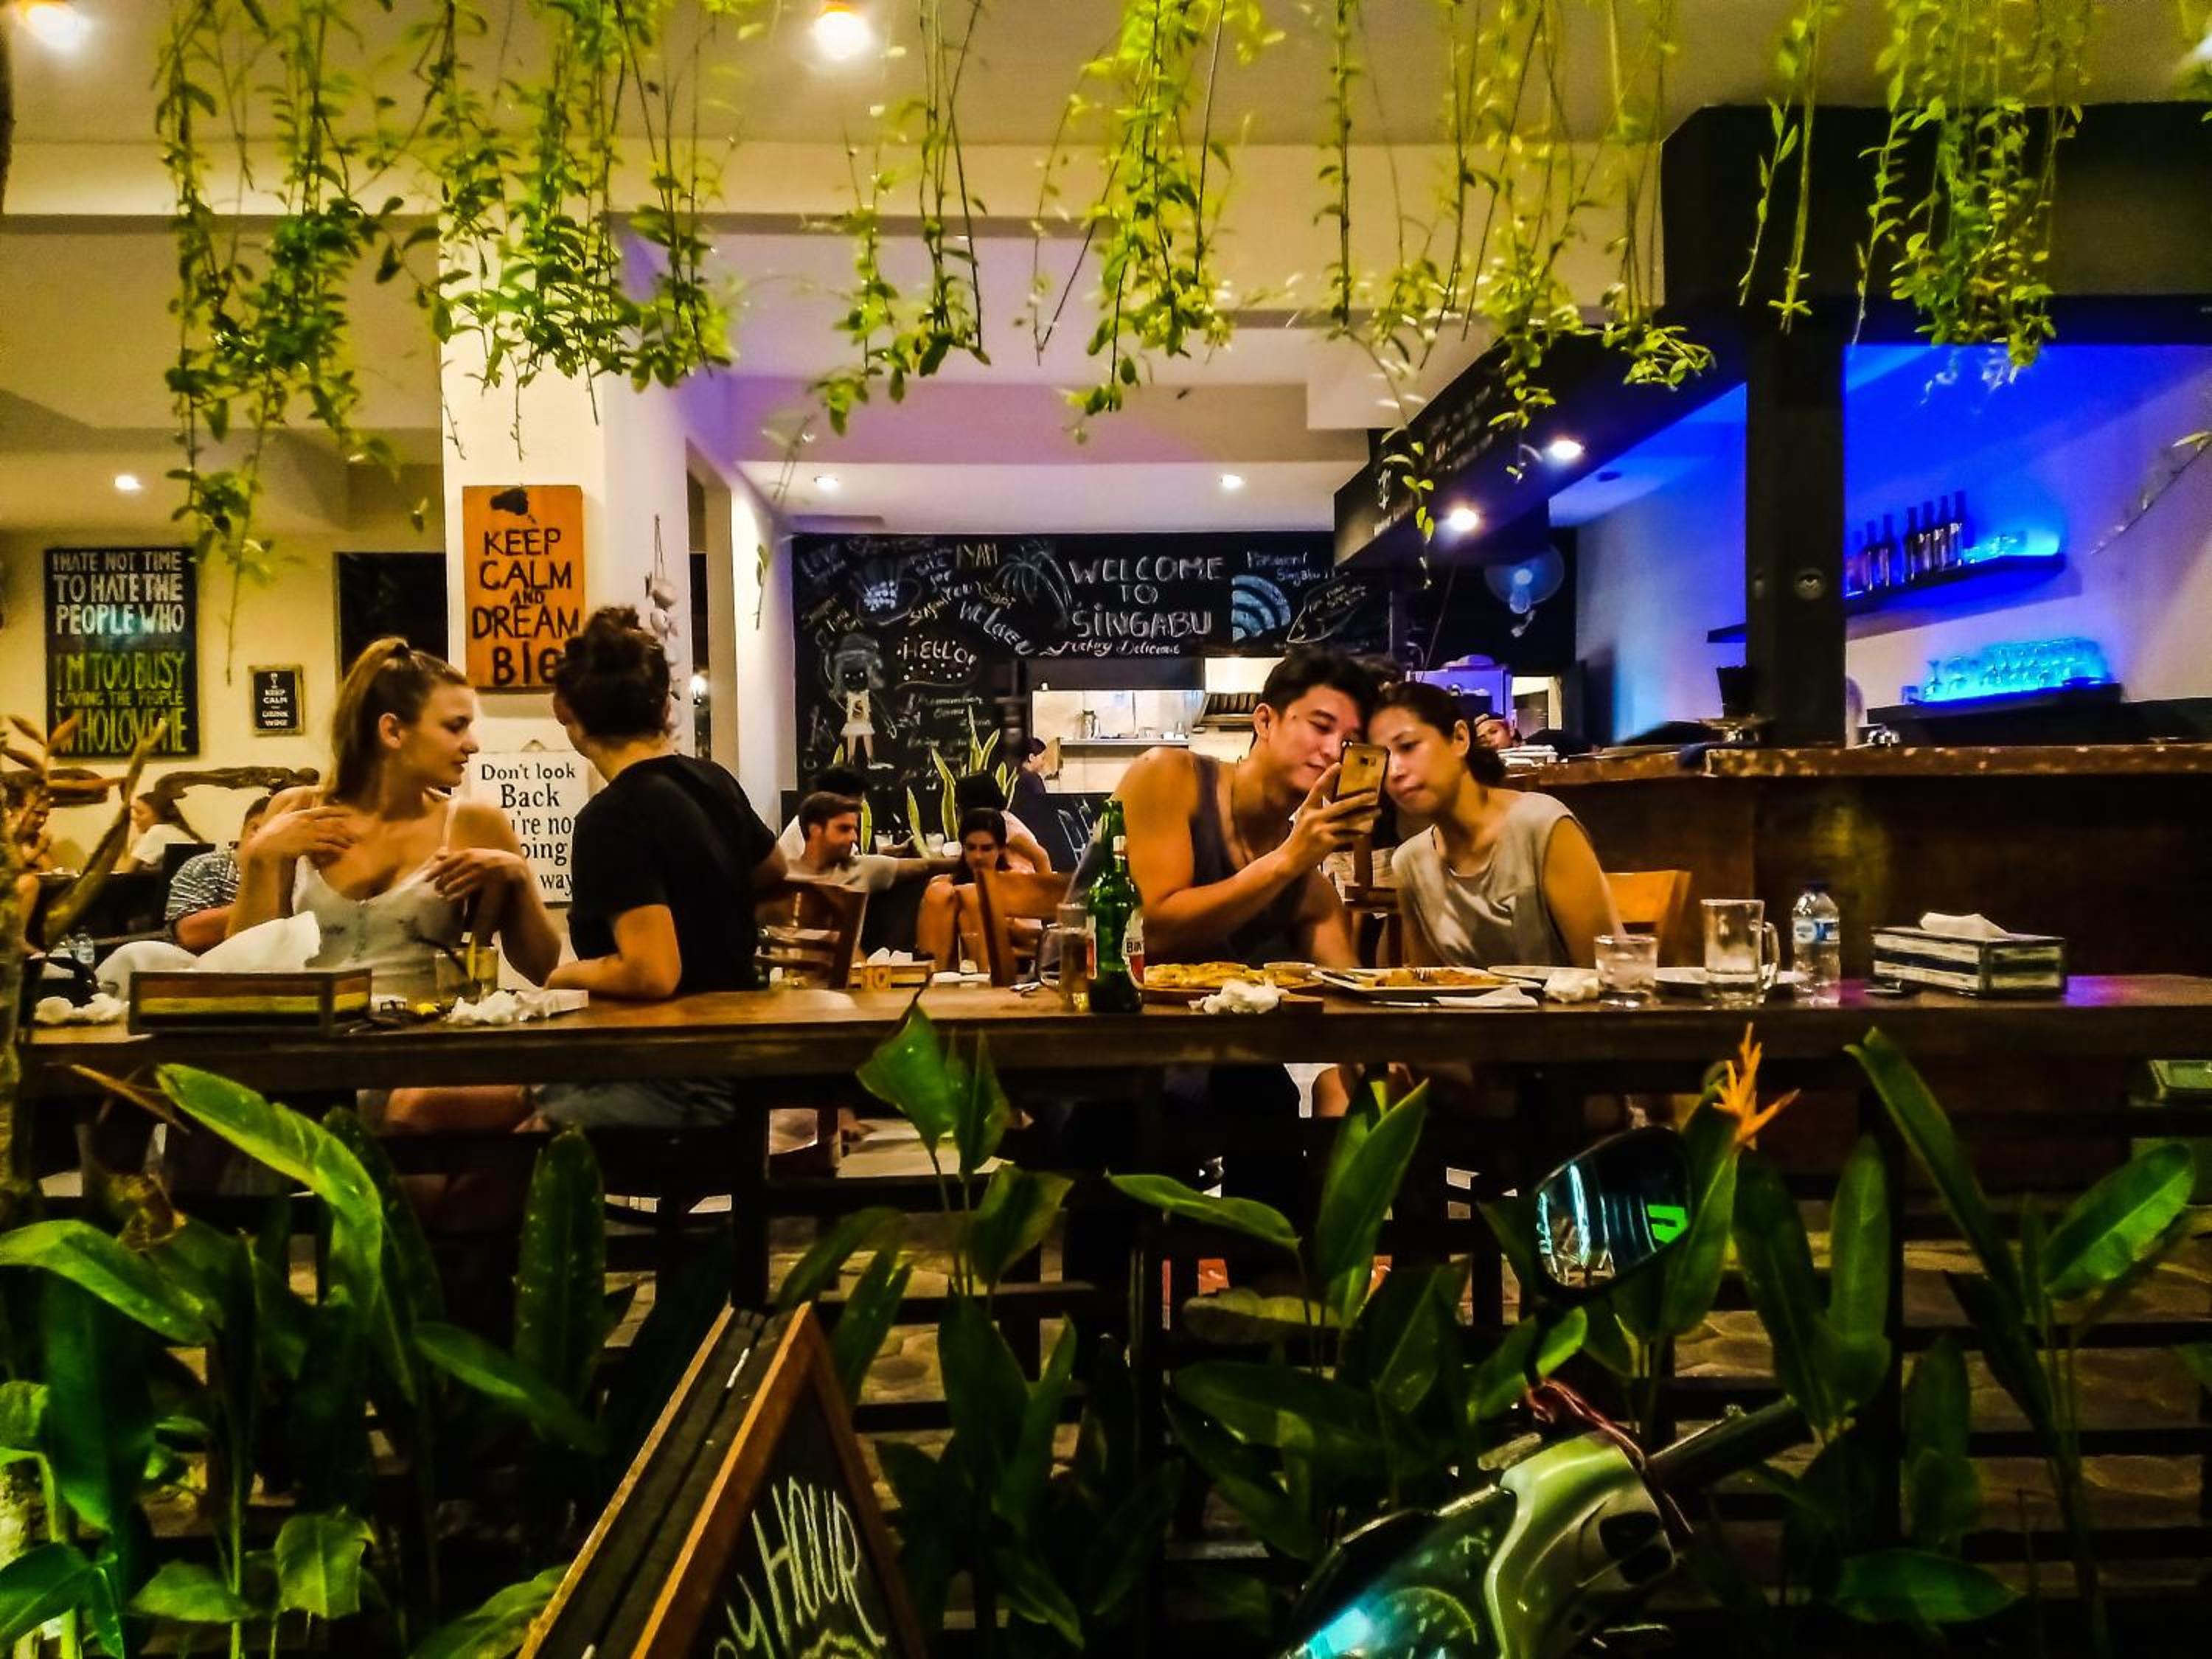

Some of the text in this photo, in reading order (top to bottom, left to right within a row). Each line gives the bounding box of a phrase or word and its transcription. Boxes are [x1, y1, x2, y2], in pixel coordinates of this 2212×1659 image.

[484, 528, 561, 556] KEEP
[144, 552, 182, 571] TIME
[479, 560, 572, 590] CALM
[1068, 556, 1224, 585] WELCOME
[53, 573, 184, 602] TO HATE THE
[509, 590, 546, 608] AND
[1121, 583, 1158, 604] TO
[55, 603, 185, 635] PEOPLE WHO
[472, 605, 579, 639] DREAM
[90, 652, 131, 690] TOO
[133, 651, 185, 689] BUSY
[481, 762, 576, 780] Don't look
[500, 782, 560, 809] Back
[549, 816, 572, 835] no
[520, 837, 568, 866] oing
[751, 1476, 886, 1652] HOUR
